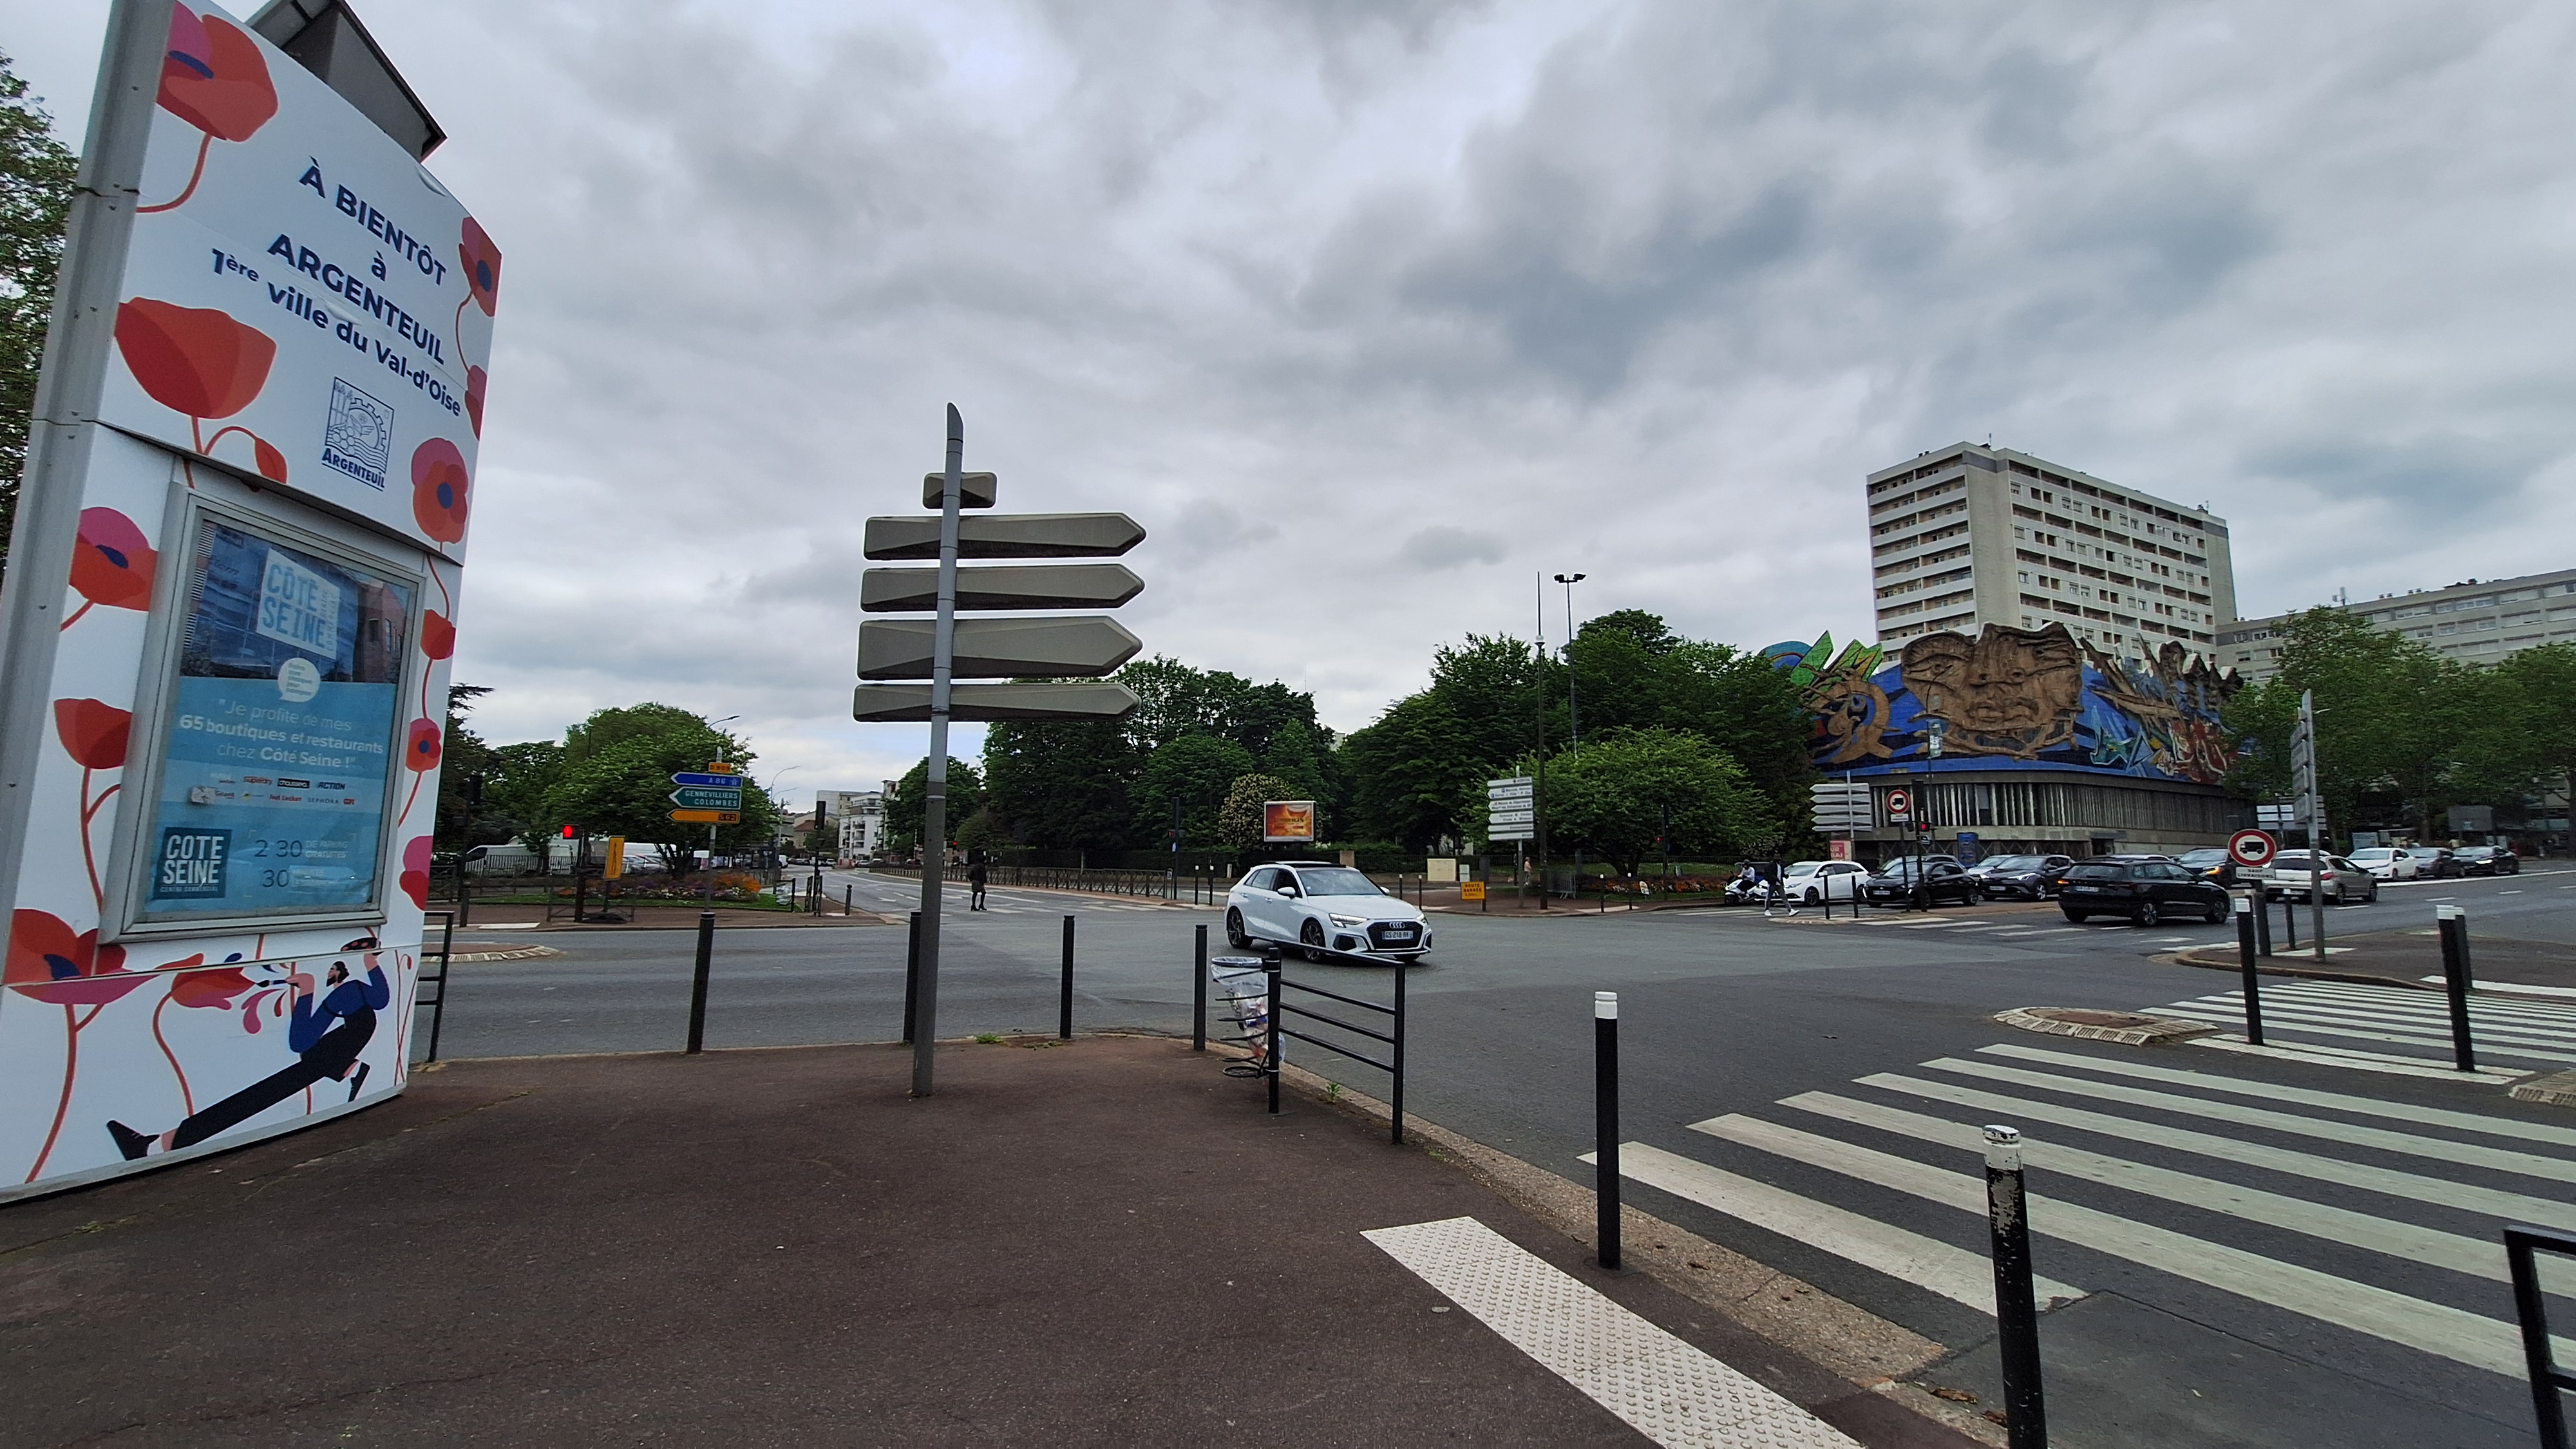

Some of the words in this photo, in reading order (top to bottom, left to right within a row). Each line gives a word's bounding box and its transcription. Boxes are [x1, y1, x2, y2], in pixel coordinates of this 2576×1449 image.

[299, 156, 326, 198] À
[336, 184, 447, 286] BIENTÔT
[370, 251, 387, 282] à
[267, 233, 445, 366] ARGENTEUIL
[212, 248, 260, 282] 1ère
[267, 282, 329, 330] ville
[336, 321, 368, 354] du
[375, 339, 461, 417] Val-d'Oise
[263, 596, 327, 649] SEINE
[251, 705, 299, 724] profite
[303, 714, 319, 726] de
[321, 717, 352, 731] mes
[179, 714, 204, 730] 65
[205, 718, 286, 741] boutiques
[291, 733, 305, 744] et
[307, 734, 384, 754] restaurants
[217, 743, 255, 759] chez
[260, 746, 298, 763] Côté
[299, 751, 341, 767] Seine
[317, 781, 346, 790] ACTION
[685, 790, 738, 799] GENNEVILLIERS
[305, 850, 347, 858] GRATUITES
[163, 859, 222, 884] SEINE
[262, 869, 289, 887] 30
